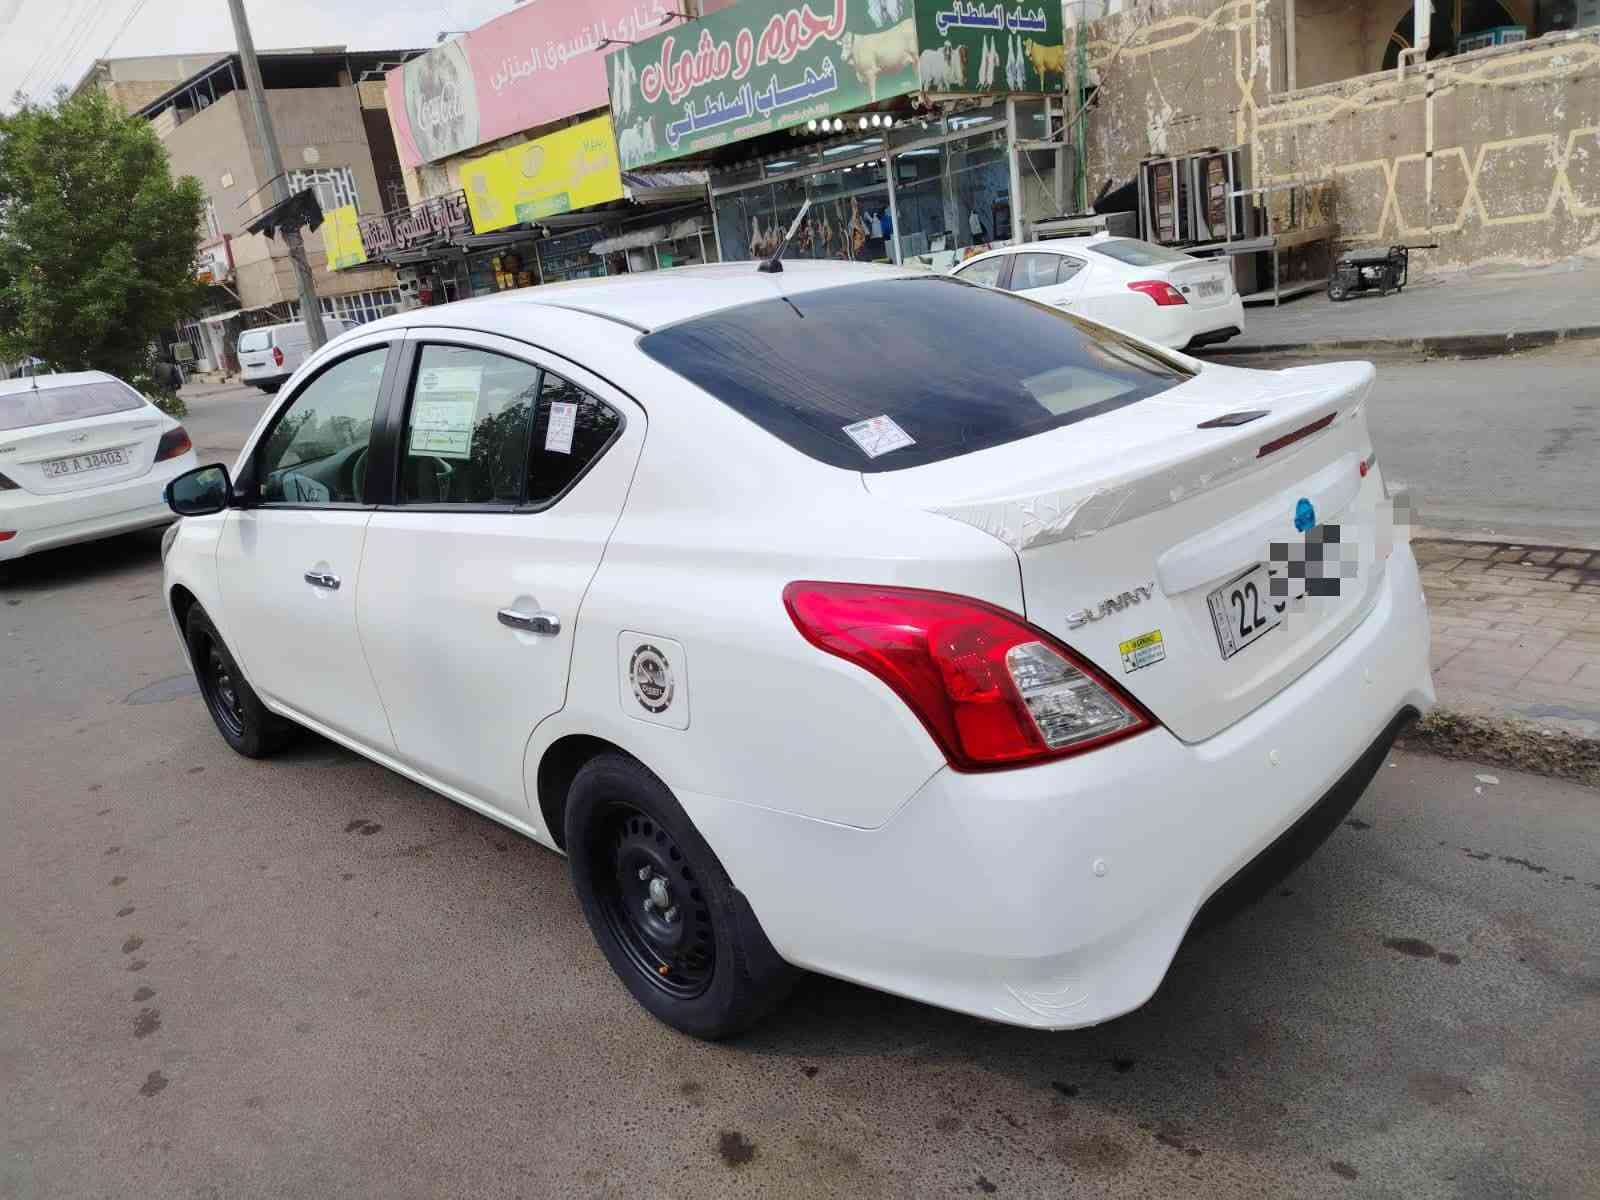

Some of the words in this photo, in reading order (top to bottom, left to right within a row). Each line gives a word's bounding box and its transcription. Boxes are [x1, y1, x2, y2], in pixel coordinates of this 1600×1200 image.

[732, 28, 754, 79] و
[1065, 582, 1155, 631] SUNNY
[1231, 581, 1267, 638] 22
